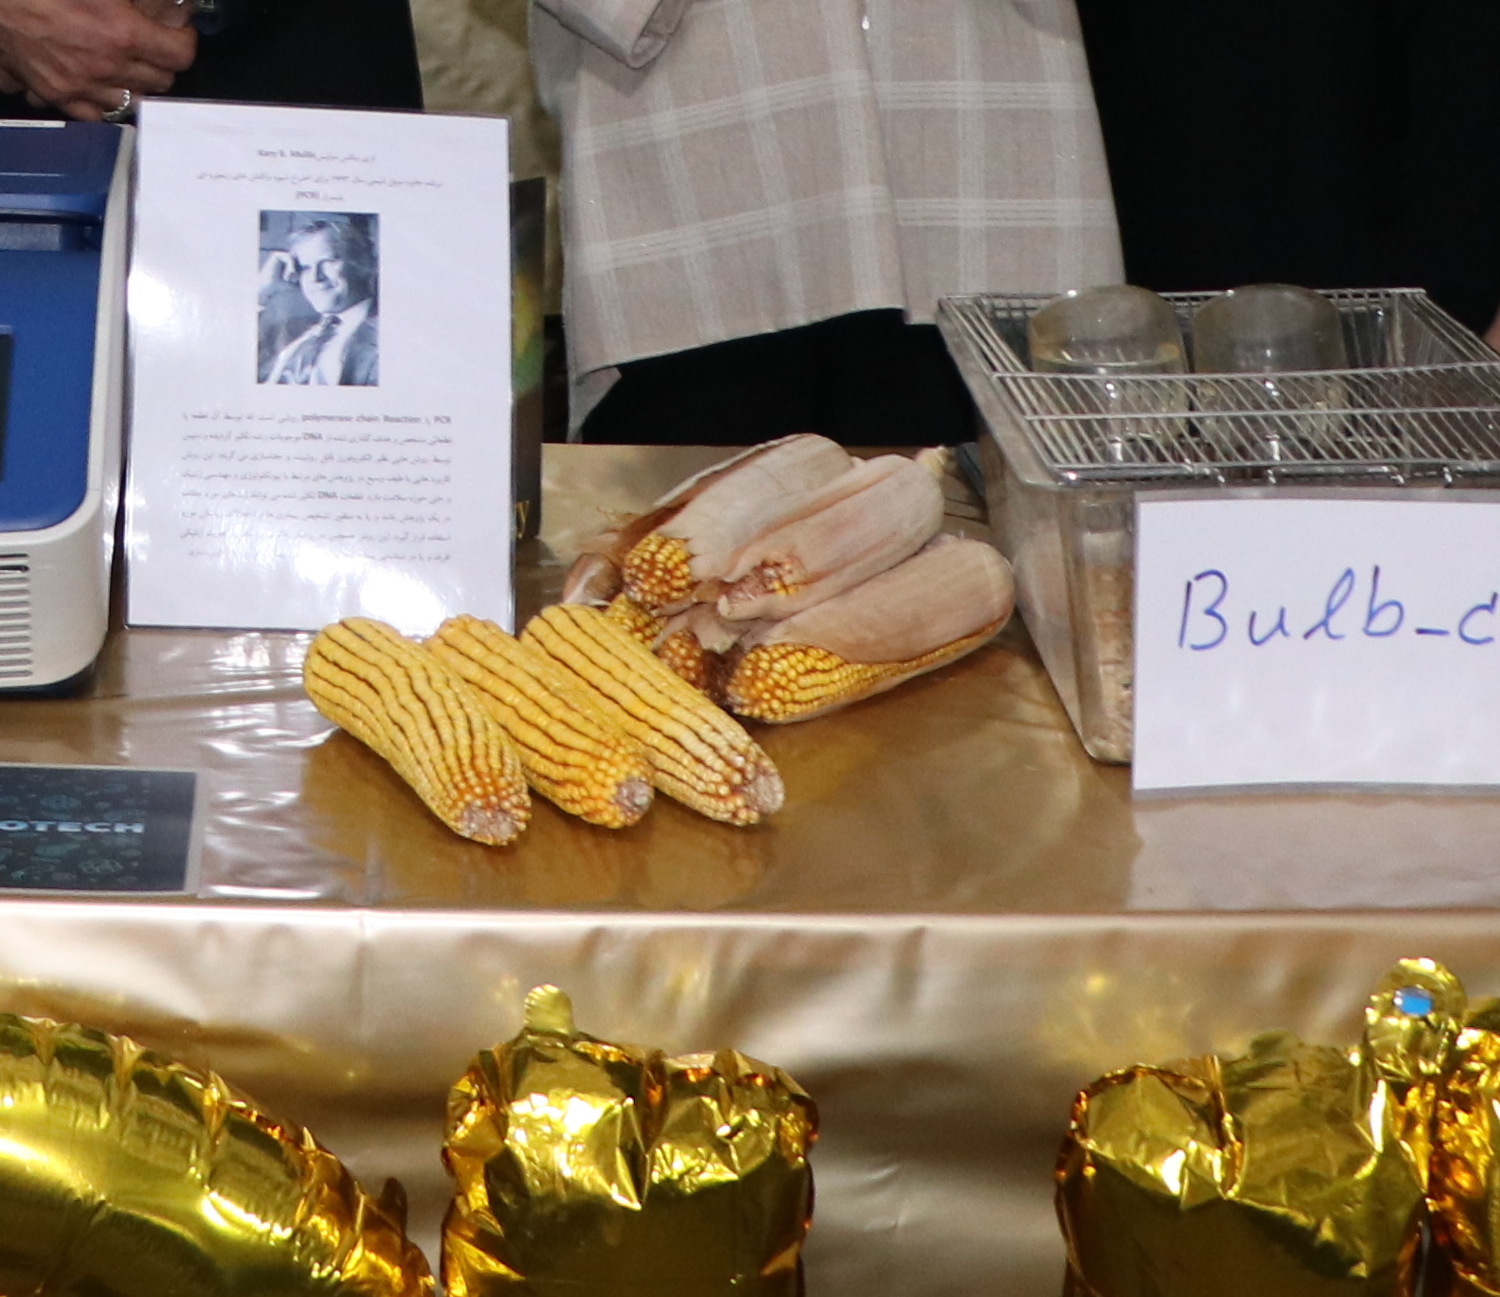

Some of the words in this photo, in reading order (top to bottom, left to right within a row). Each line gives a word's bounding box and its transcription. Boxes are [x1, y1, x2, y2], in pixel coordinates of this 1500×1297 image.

[301, 413, 353, 423] polymerase
[355, 414, 380, 424] chain
[383, 414, 422, 424] Reaction
[301, 432, 323, 441] DNA
[317, 491, 338, 500] DNA
